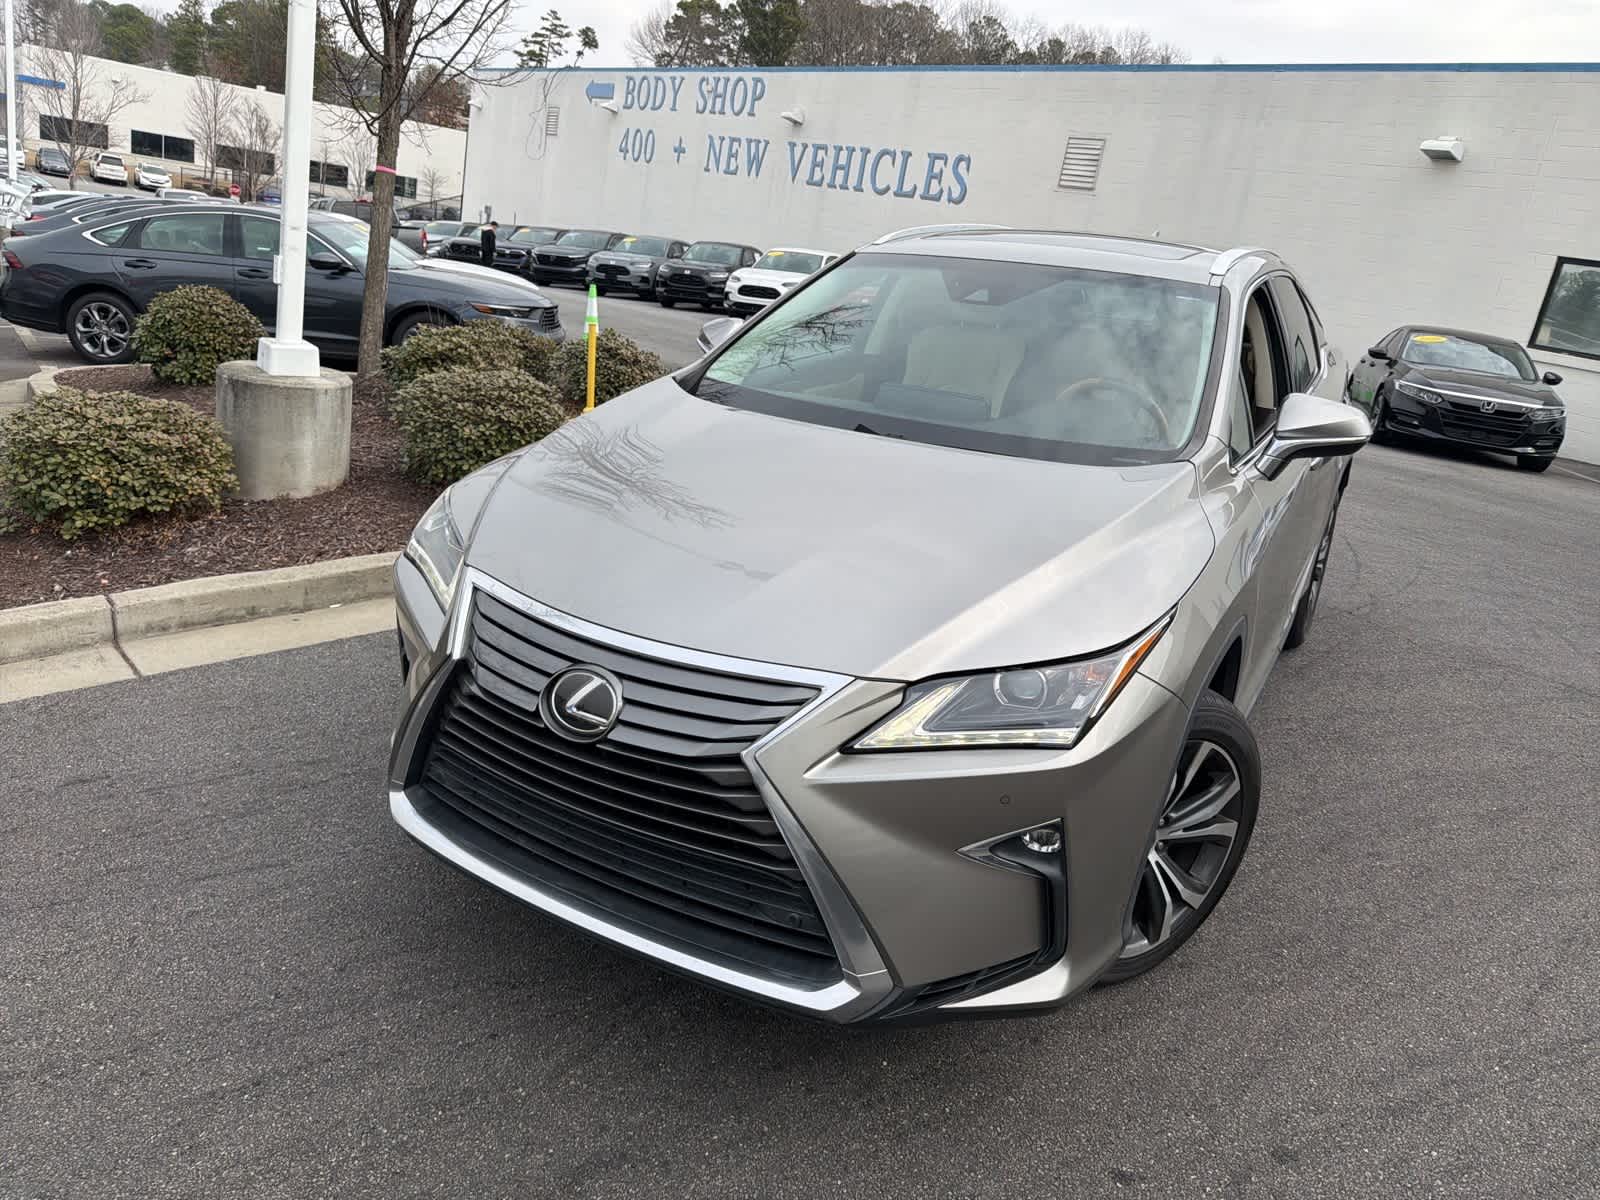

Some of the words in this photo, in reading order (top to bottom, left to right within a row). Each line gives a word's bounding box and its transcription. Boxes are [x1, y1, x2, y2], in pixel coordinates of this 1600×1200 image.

[623, 75, 684, 113] BODY
[695, 76, 766, 117] SHOP
[619, 127, 656, 164] 400
[703, 135, 770, 178] NEW
[787, 141, 972, 205] VEHICLES
